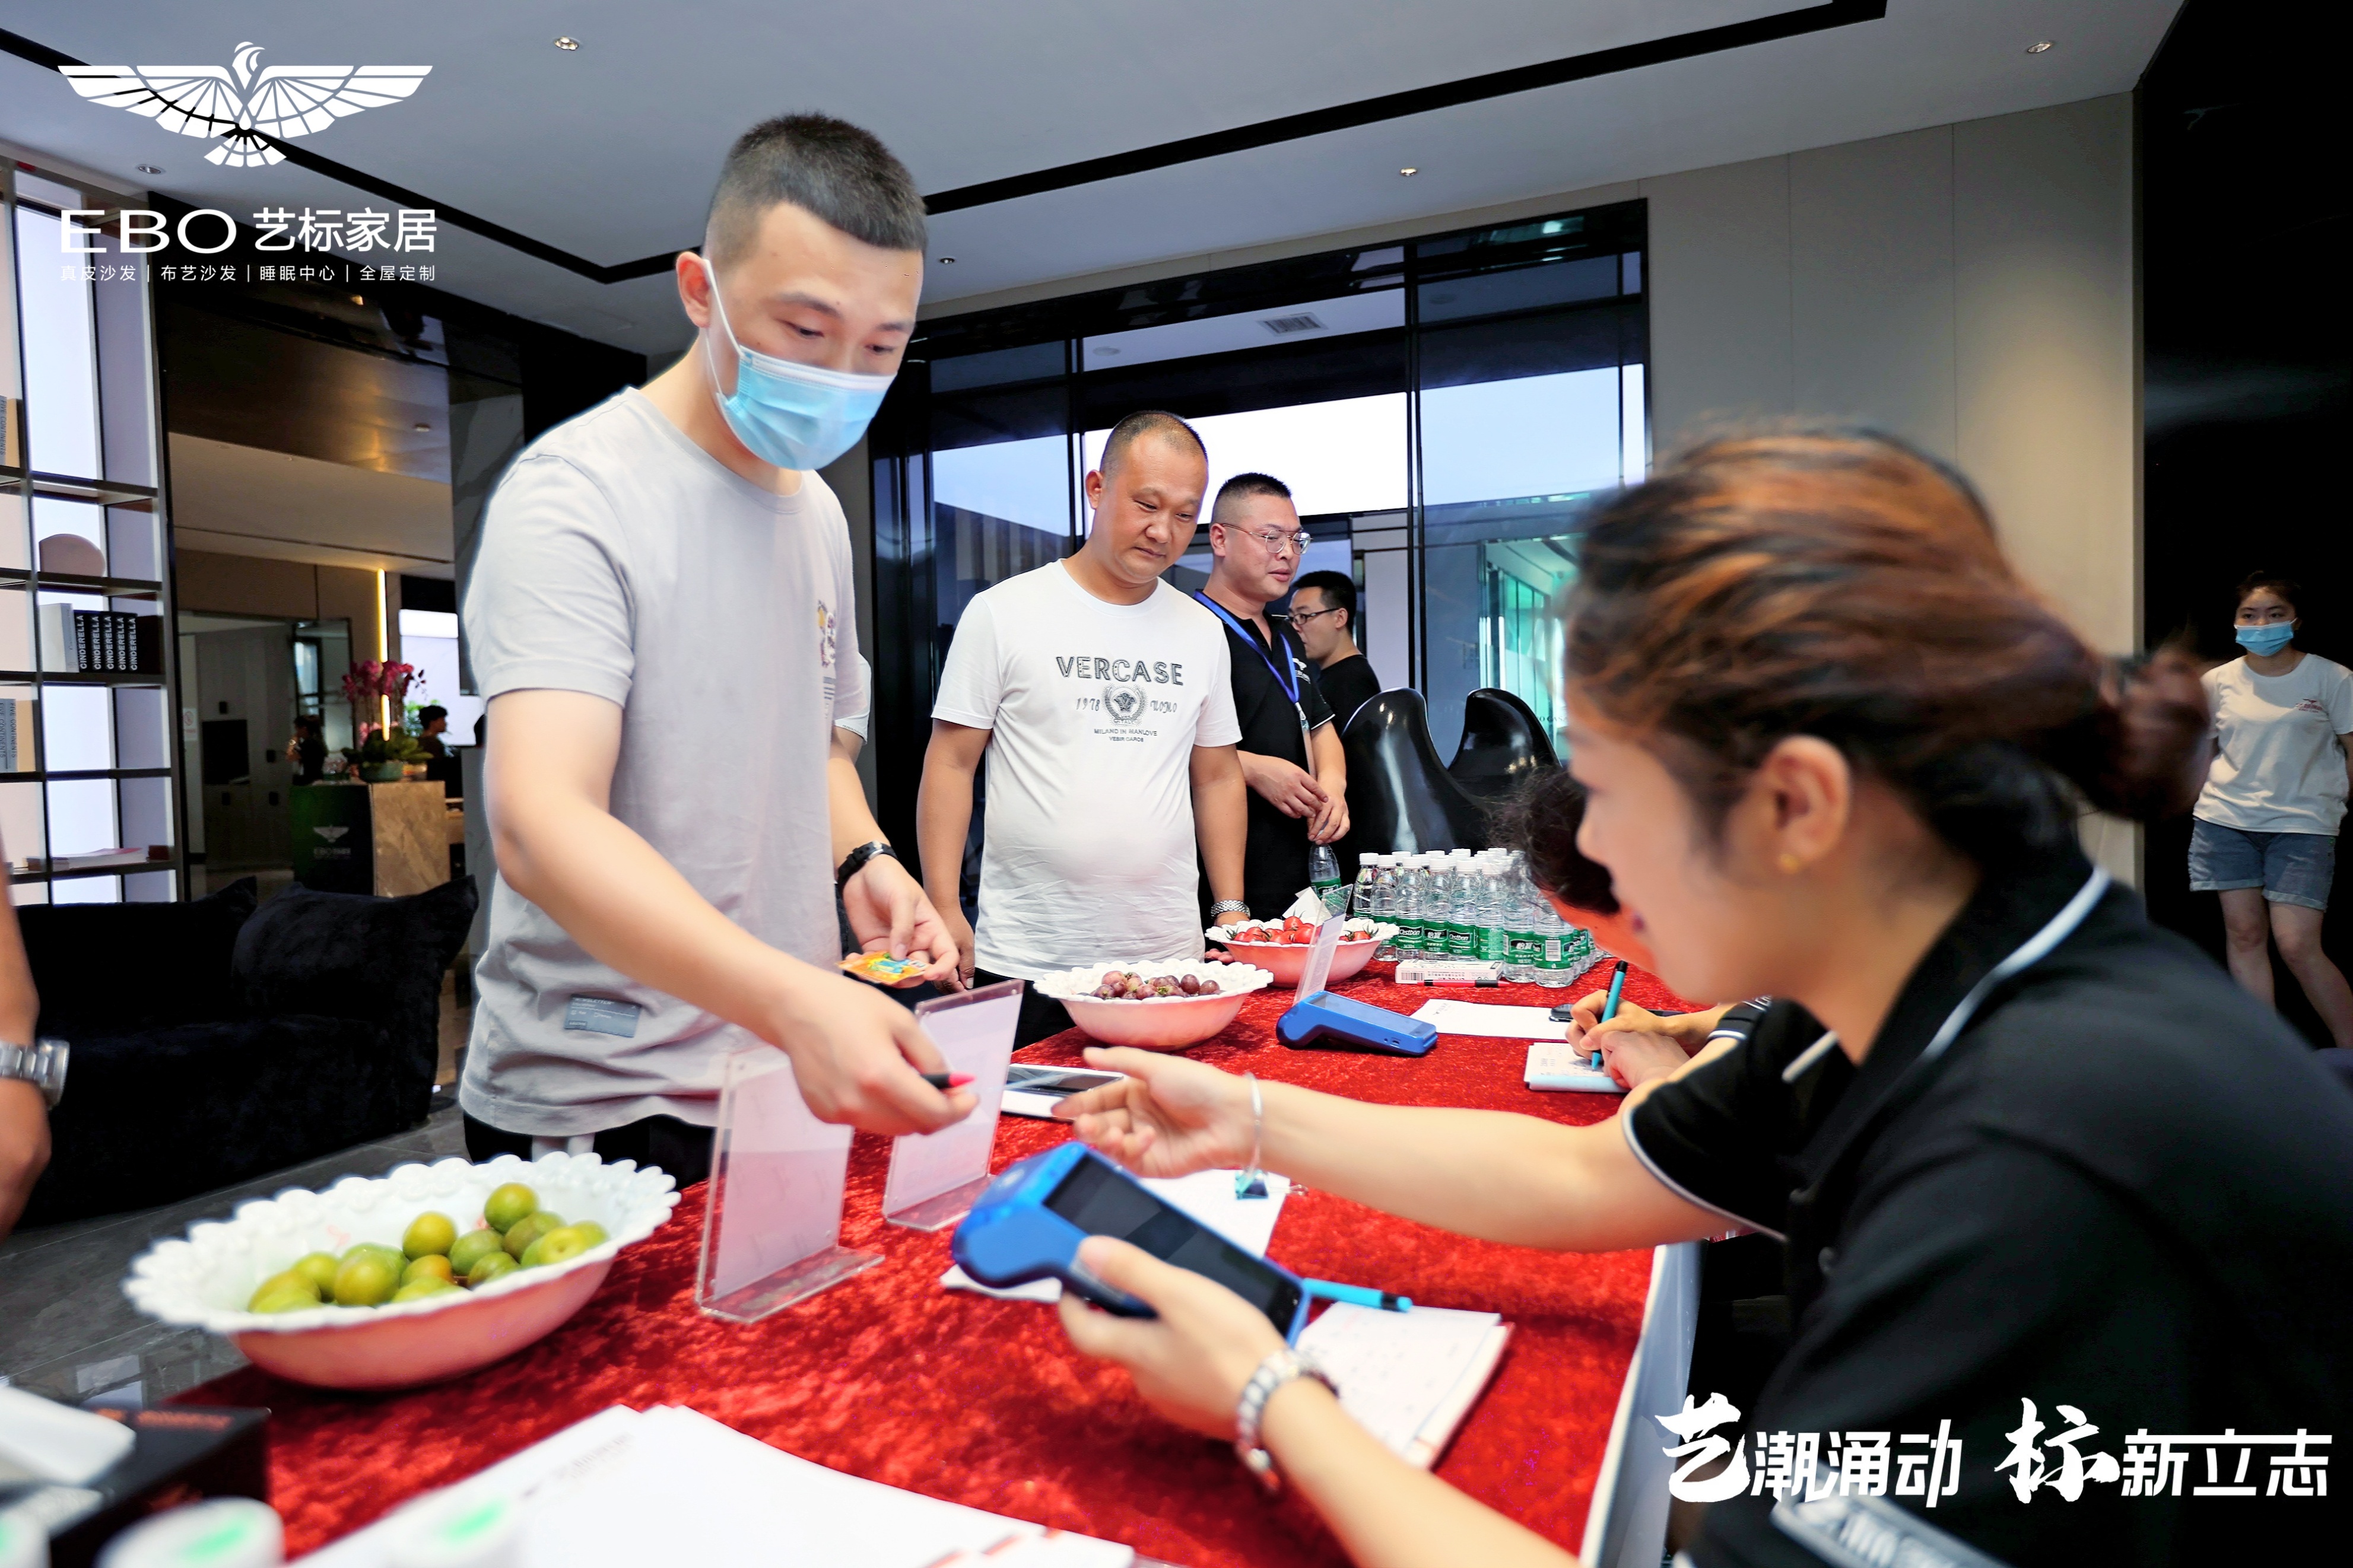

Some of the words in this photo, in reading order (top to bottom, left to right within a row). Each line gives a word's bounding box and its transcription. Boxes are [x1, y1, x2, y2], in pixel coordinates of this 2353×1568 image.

[76, 615, 87, 669] CINDERELLA
[91, 616, 101, 670] CINDERELLA
[104, 616, 114, 670] CINDERELLA
[117, 617, 126, 670] CINDERELLA
[128, 618, 138, 670] CINDERELLA
[1055, 656, 1184, 686] VERCASE
[1076, 697, 1100, 711] 1978
